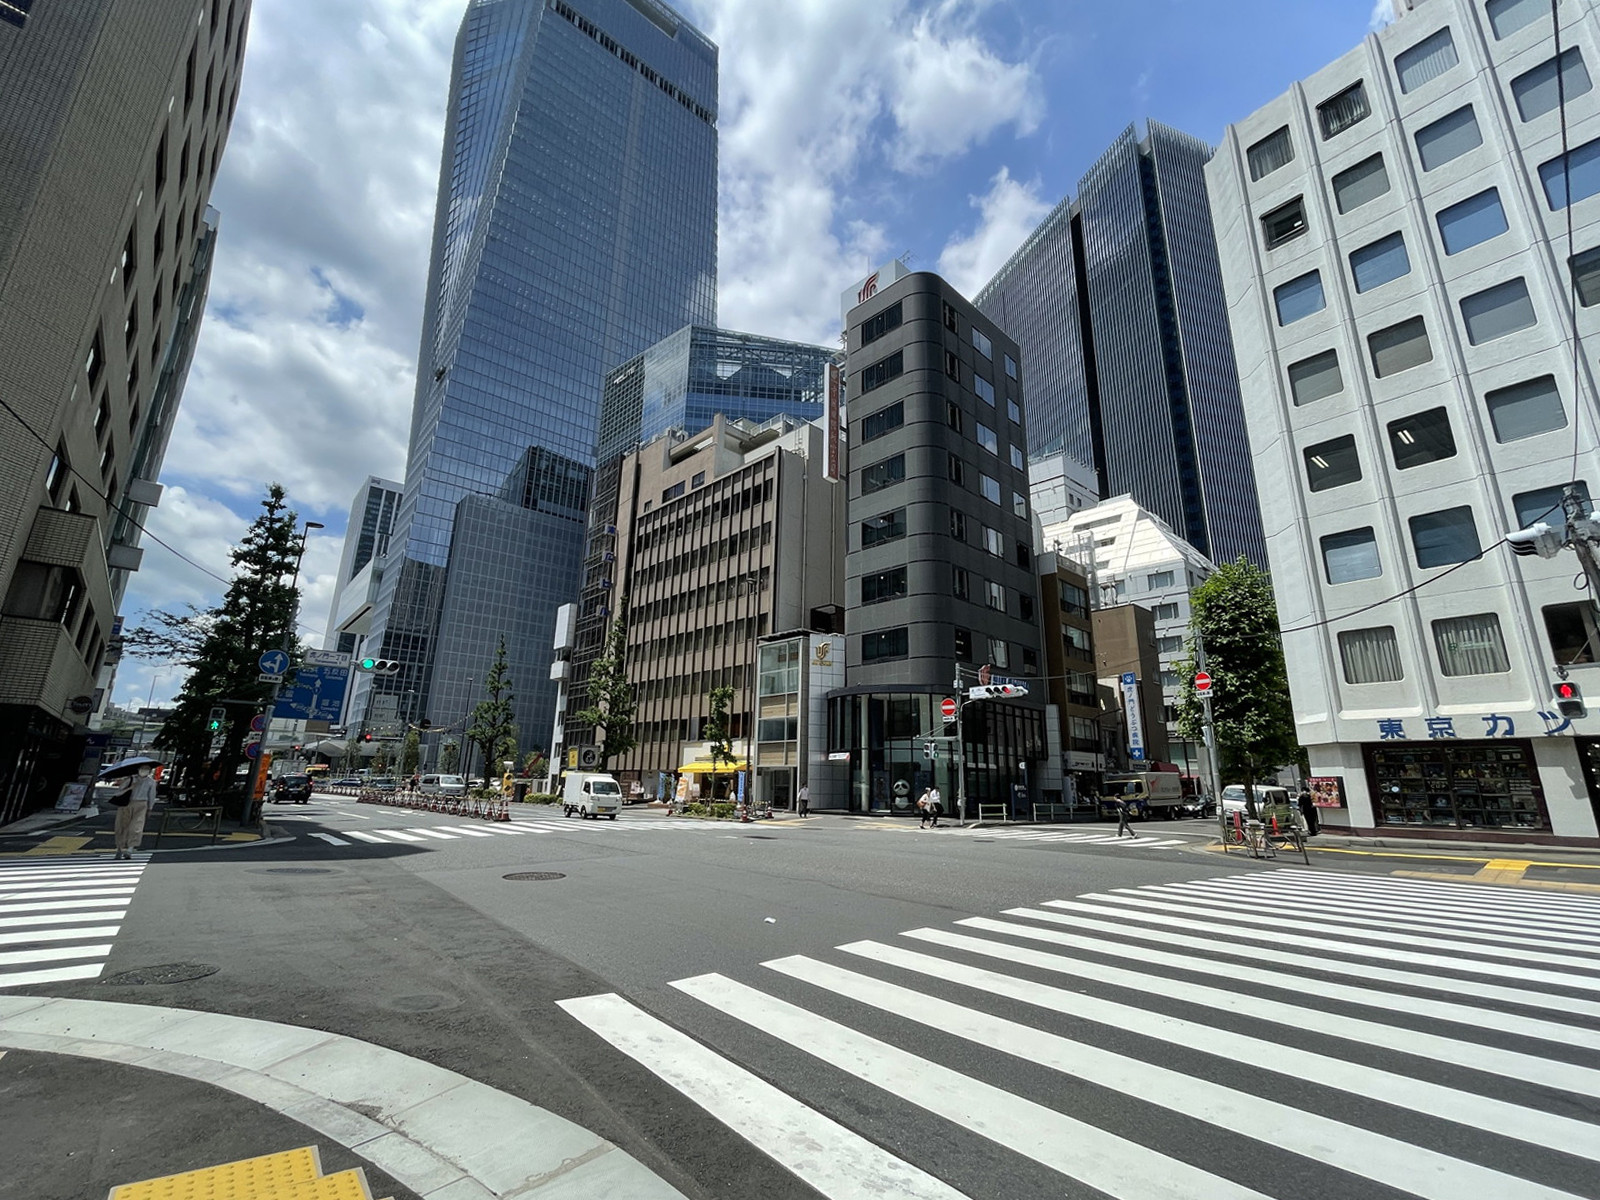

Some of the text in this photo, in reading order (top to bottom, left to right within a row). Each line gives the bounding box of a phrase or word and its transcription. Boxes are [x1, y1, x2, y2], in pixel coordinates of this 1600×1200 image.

[310, 651, 347, 661] 虎ノ門一丁目
[324, 667, 348, 677] 五反田
[1126, 686, 1140, 746] 虎ノ門どうぶつ病院
